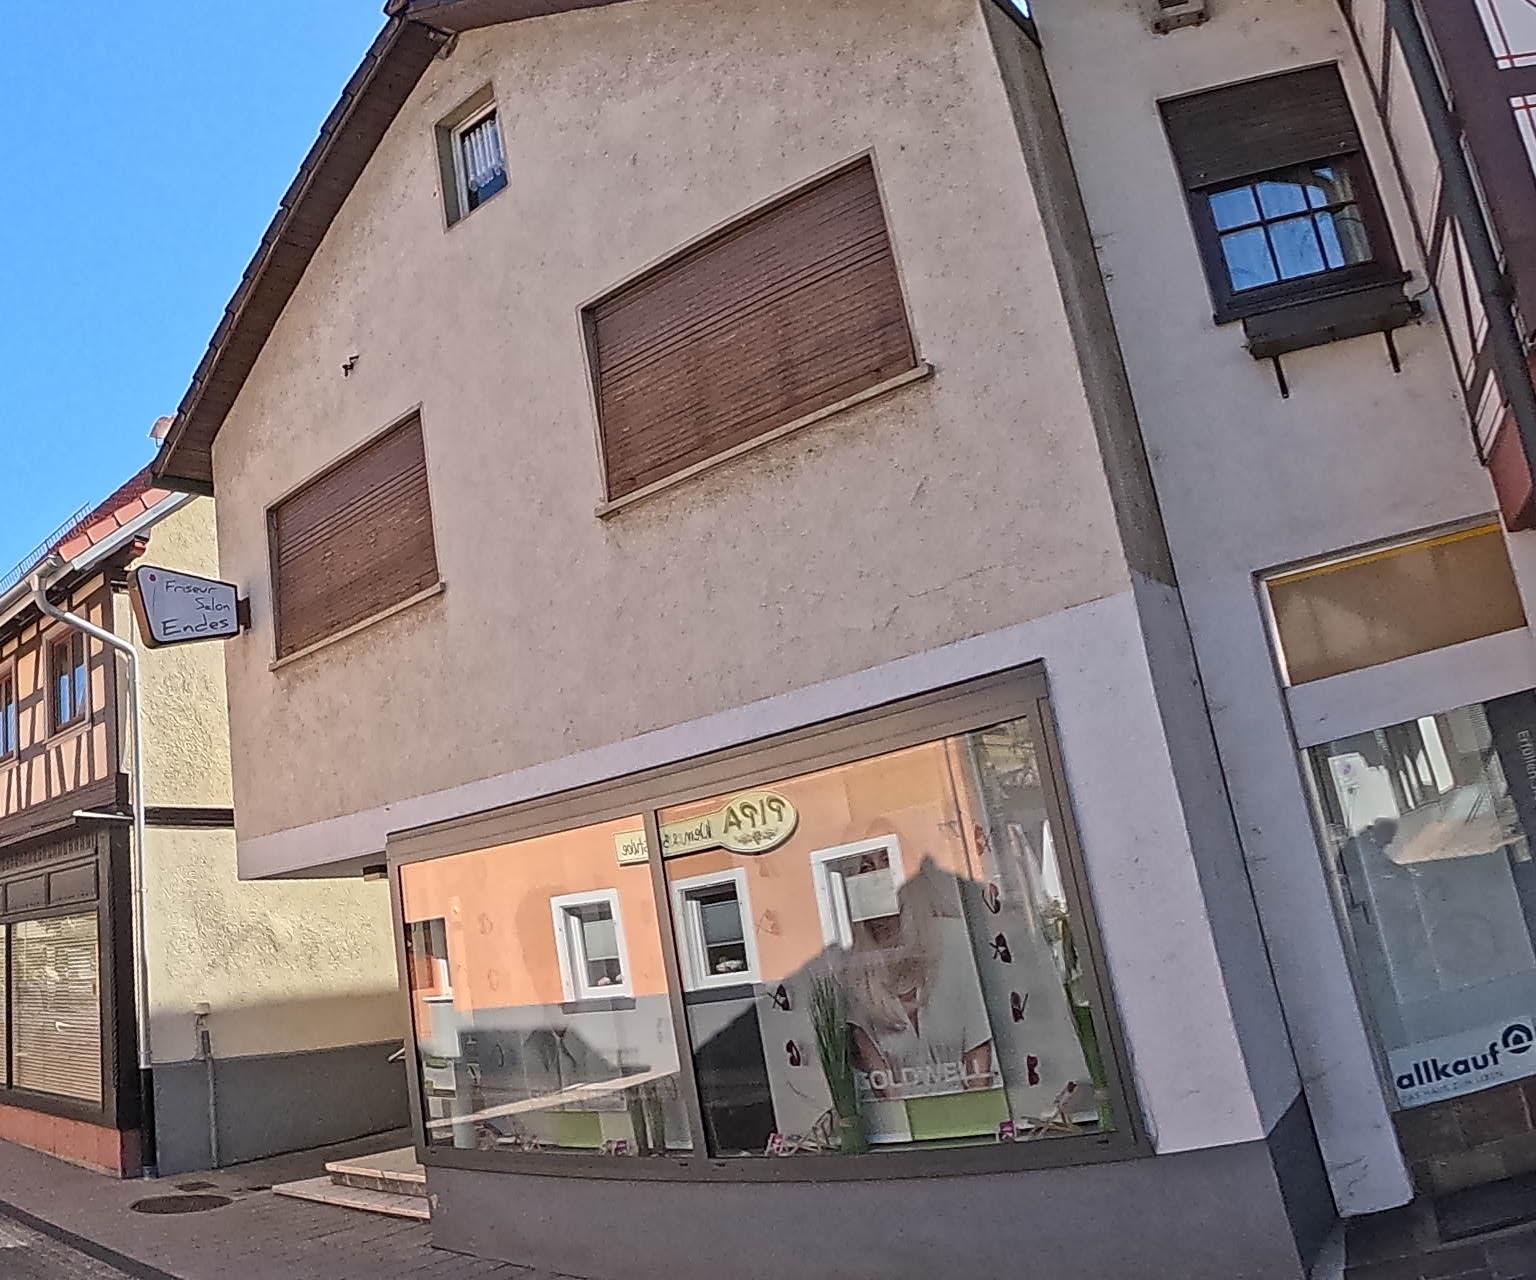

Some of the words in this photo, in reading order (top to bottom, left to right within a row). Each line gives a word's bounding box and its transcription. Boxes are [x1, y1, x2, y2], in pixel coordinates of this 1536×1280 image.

[165, 580, 218, 594] Friseur
[195, 597, 231, 612] Salon
[161, 613, 230, 637] Endes
[1396, 1042, 1501, 1090] allkauf
